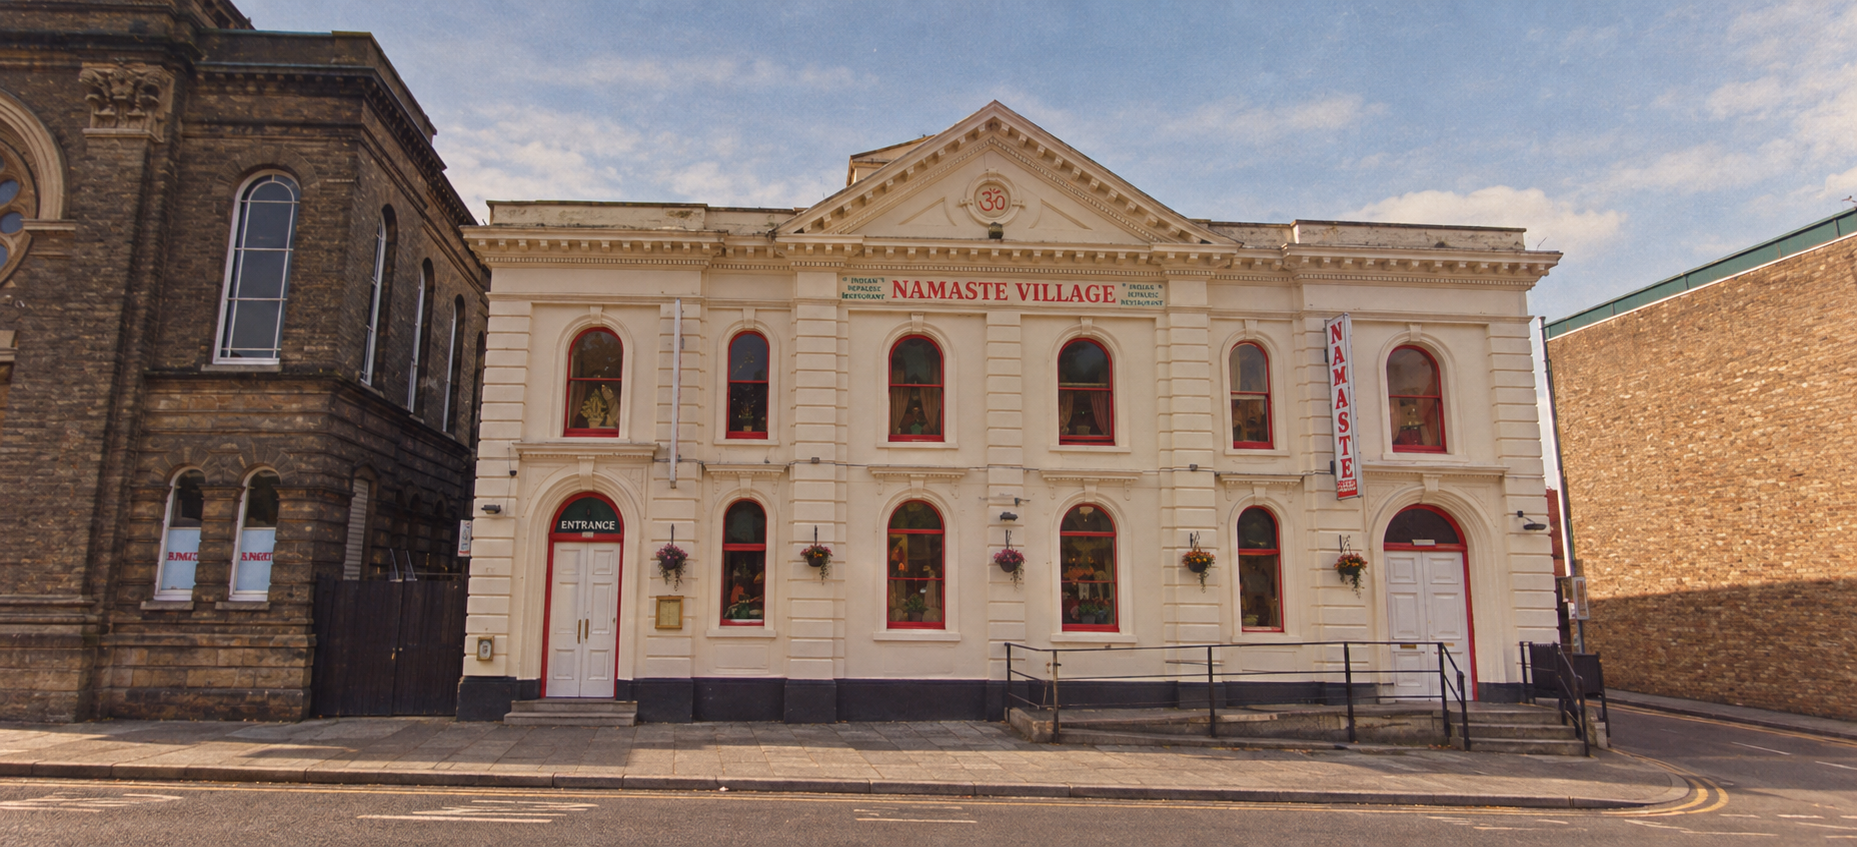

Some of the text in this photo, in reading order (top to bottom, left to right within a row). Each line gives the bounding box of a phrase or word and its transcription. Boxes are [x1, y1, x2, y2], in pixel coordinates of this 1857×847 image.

[892, 280, 1116, 304] NAMASTE VILLAGE
[1330, 321, 1353, 480] NAMASTE
[561, 520, 615, 530] ENTRANCE
